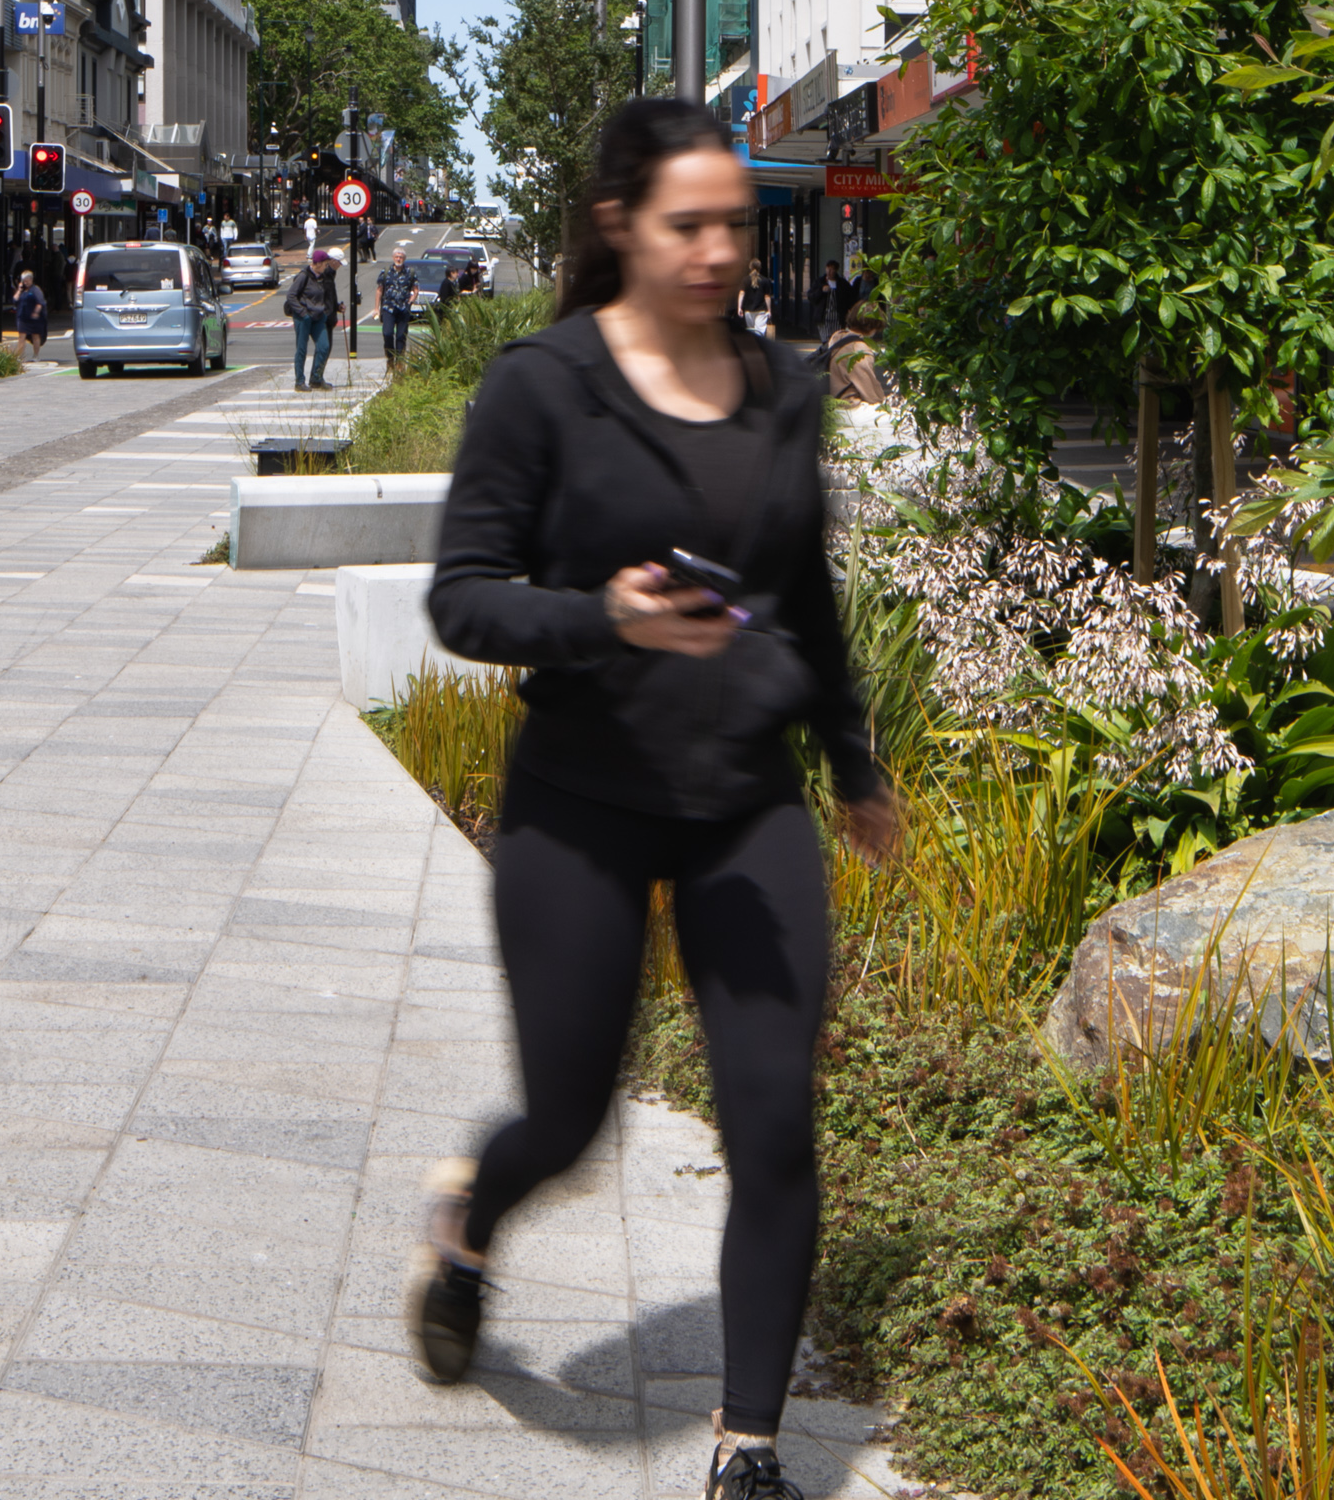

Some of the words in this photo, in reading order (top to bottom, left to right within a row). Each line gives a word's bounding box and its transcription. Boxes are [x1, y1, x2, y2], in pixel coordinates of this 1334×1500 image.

[833, 174, 862, 186] CITY
[75, 197, 89, 207] 30
[343, 192, 361, 205] 30
